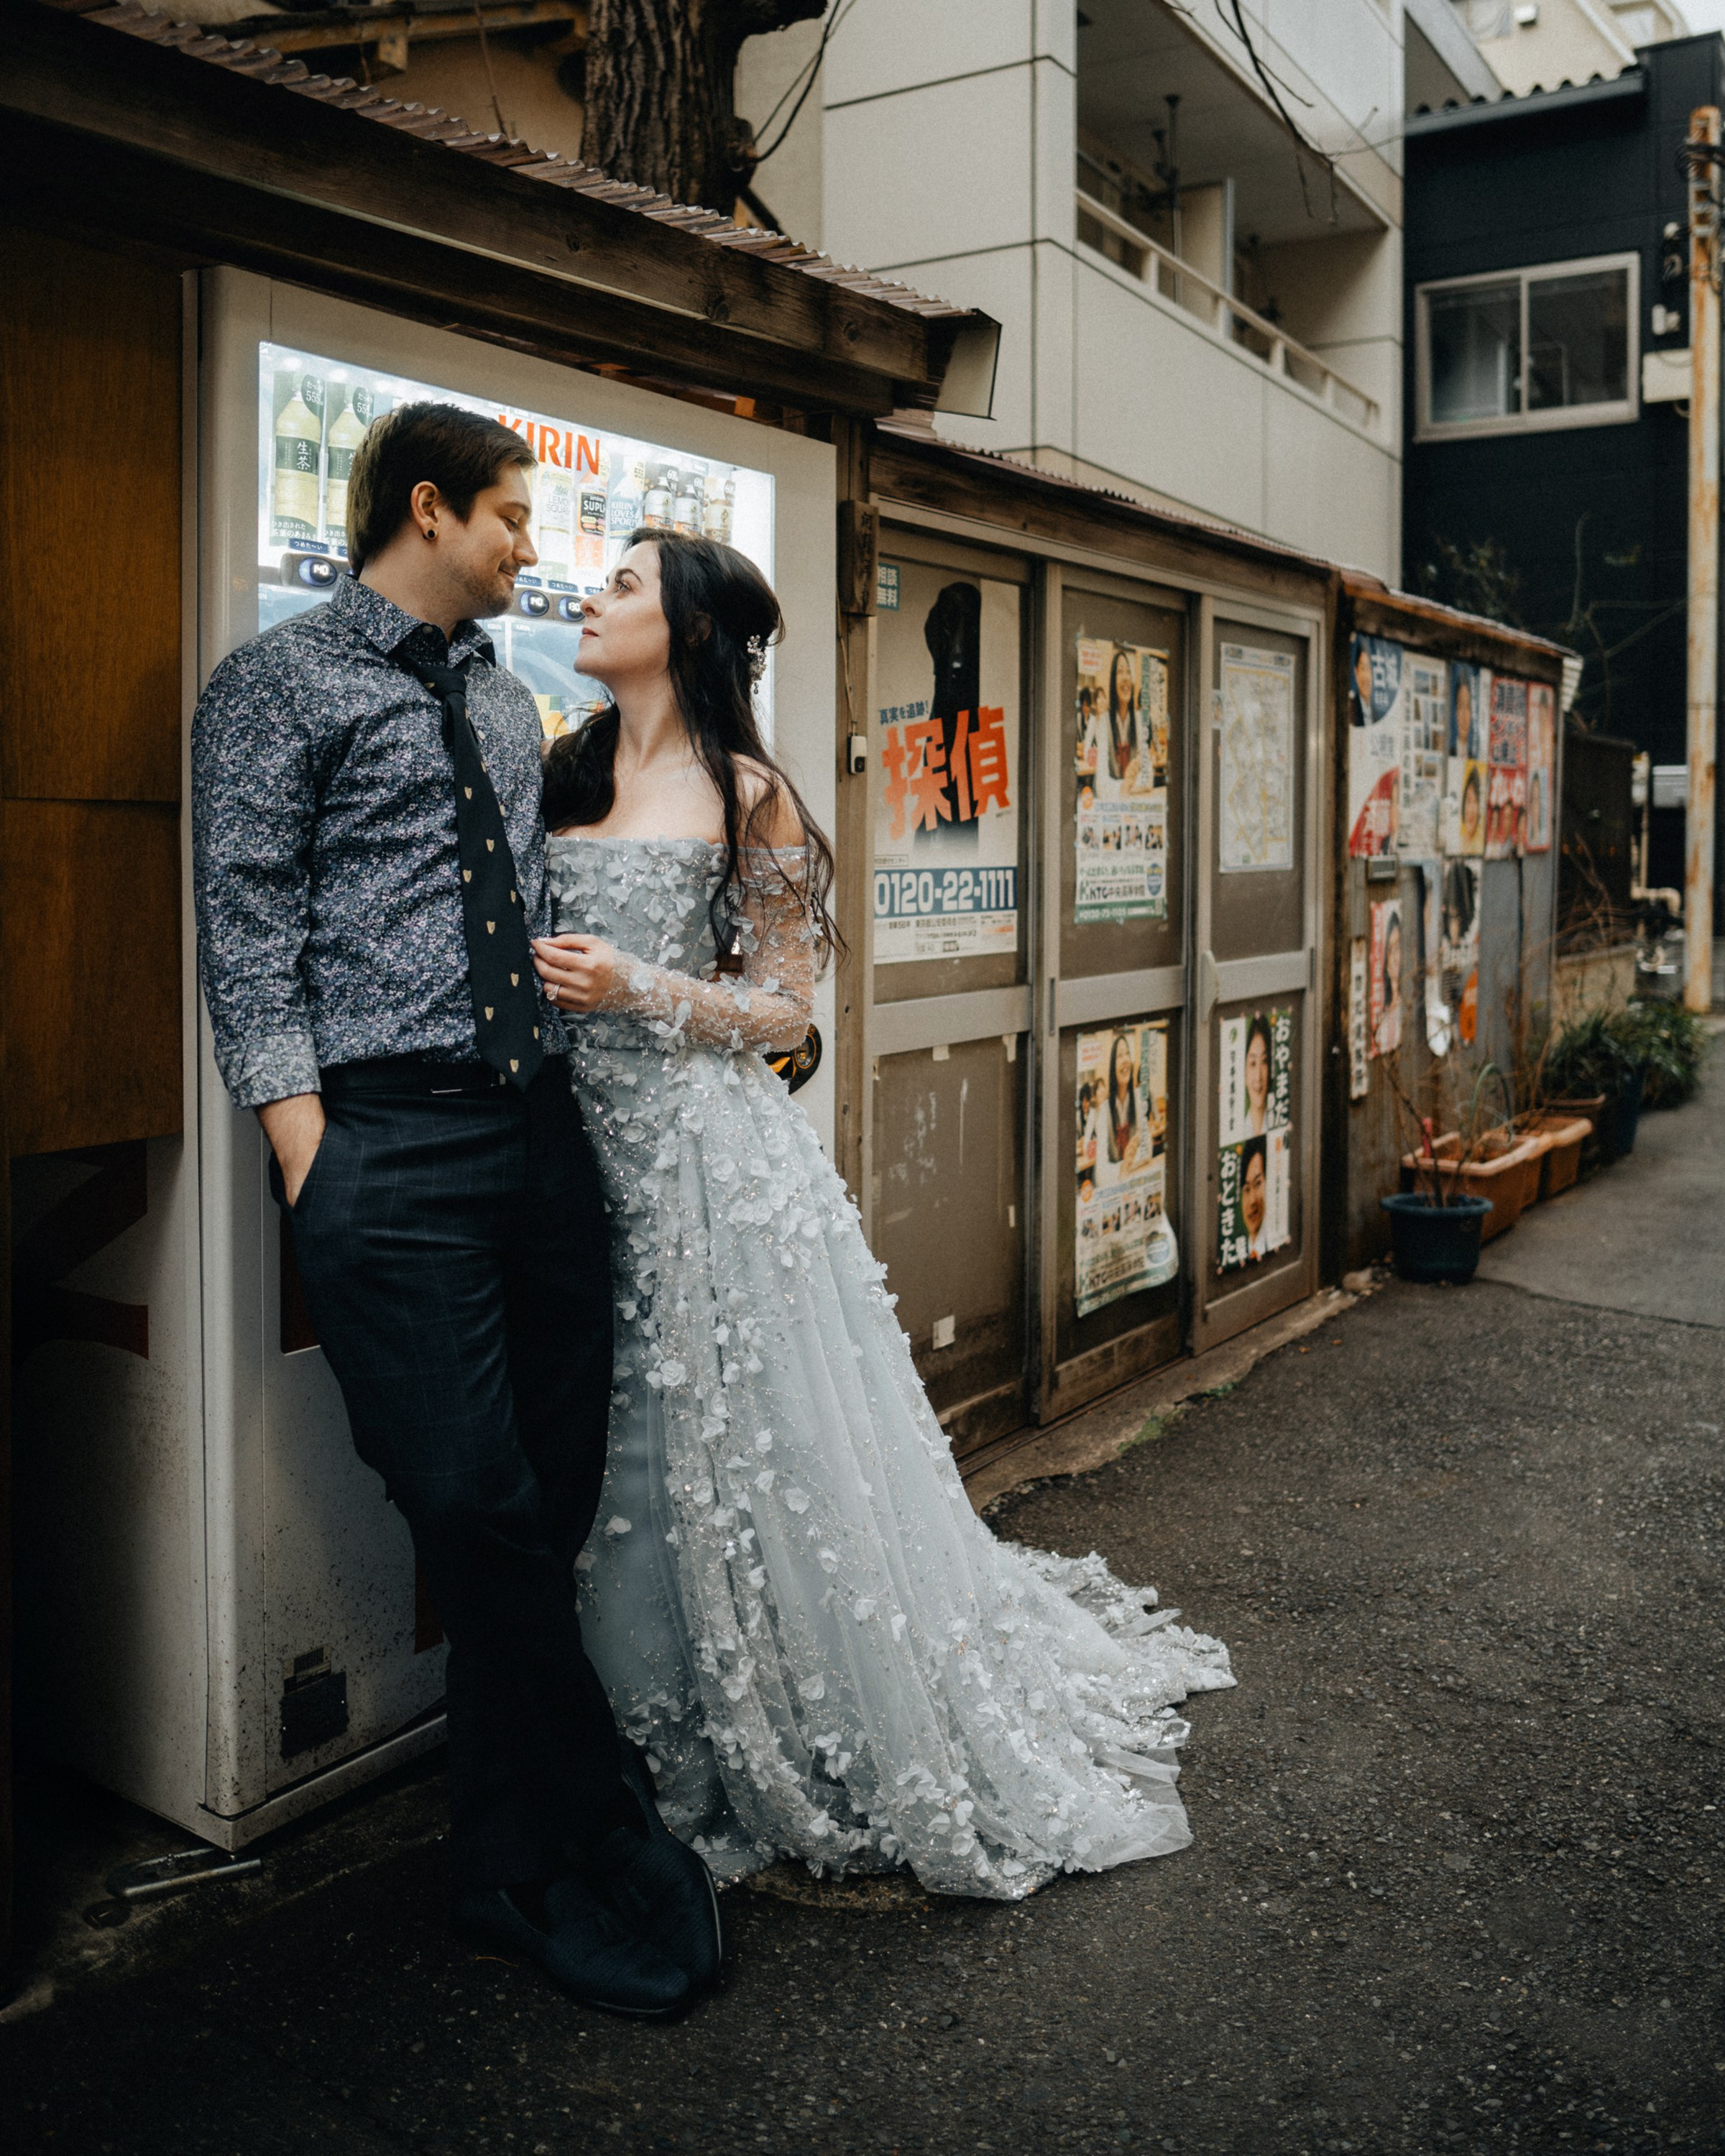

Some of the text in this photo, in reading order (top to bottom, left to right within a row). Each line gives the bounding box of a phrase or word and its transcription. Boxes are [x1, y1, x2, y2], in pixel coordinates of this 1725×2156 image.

[296, 441, 310, 471] 生茶
[611, 510, 634, 519] LOVES
[612, 502, 633, 510] KIRIN
[313, 563, 330, 576] 140
[530, 596, 543, 607] 140
[881, 705, 1011, 841] 探偵
[874, 869, 1014, 916] 0120-22-1111
[1274, 1014, 1291, 1129] おやまだ
[1220, 1149, 1237, 1268] おときた
